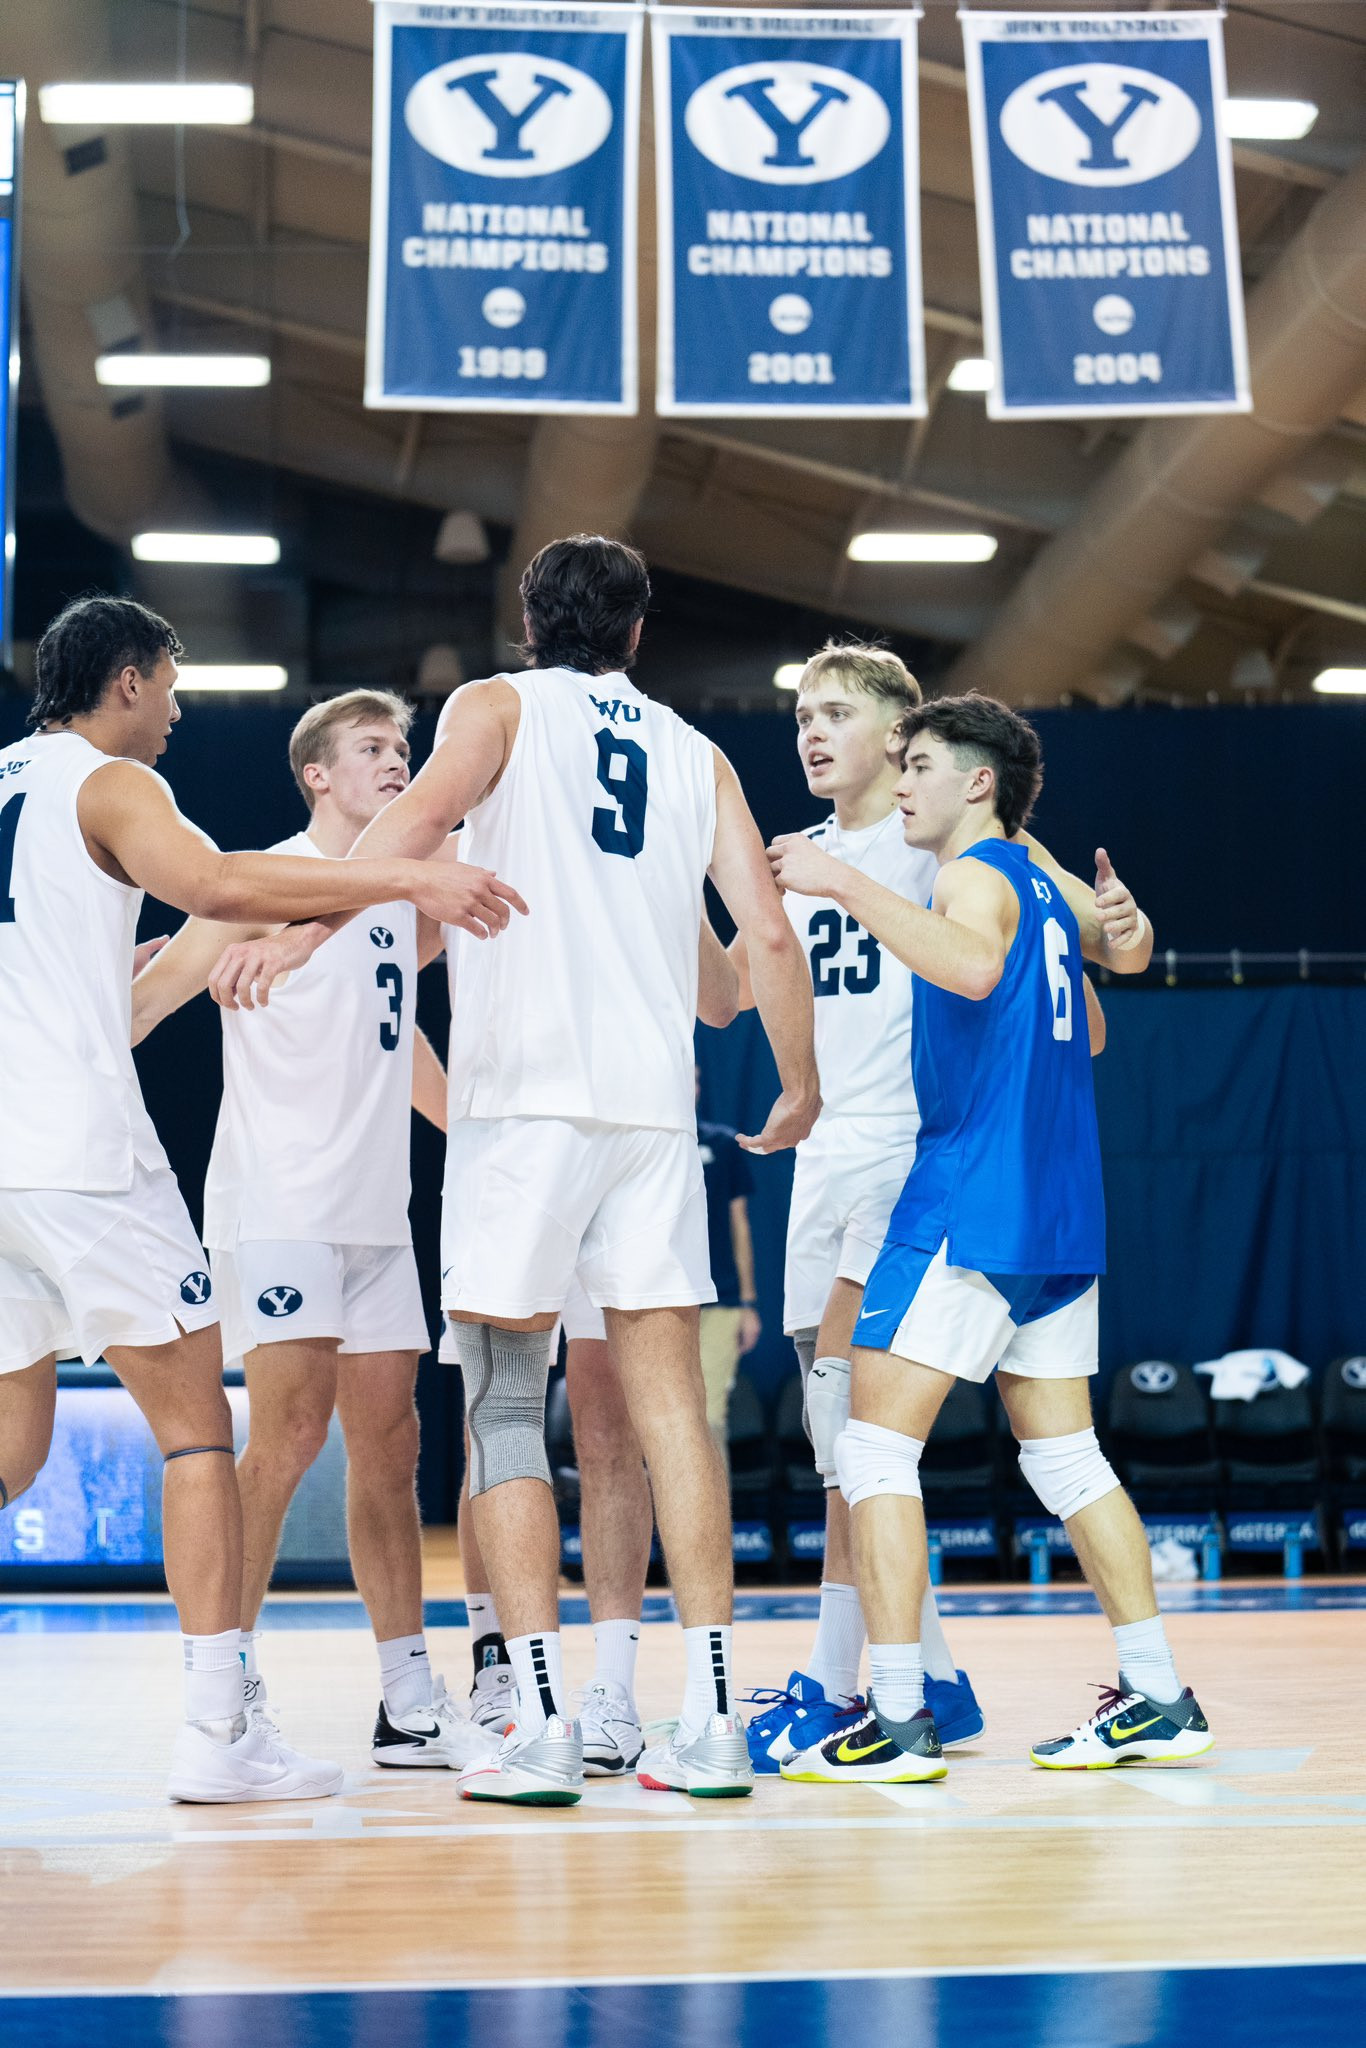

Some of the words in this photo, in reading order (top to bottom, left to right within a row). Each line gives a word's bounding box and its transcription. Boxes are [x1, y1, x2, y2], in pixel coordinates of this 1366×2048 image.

[445, 69, 572, 161] Y
[724, 78, 850, 167] Y
[1036, 80, 1160, 169] Y
[422, 202, 591, 237] NATIONAL
[706, 210, 873, 243] NATIONAL
[1027, 211, 1191, 244] NATIONAL
[402, 236, 609, 274] CHAMPIONS
[687, 244, 893, 278] CHAMPIONS
[1010, 244, 1211, 280] CHAMPIONS
[457, 346, 547, 380] 1999
[747, 352, 835, 385] 2001
[1073, 352, 1163, 385] 2004
[591, 727, 648, 860] 9
[808, 908, 882, 997] 23
[1043, 917, 1073, 1041] 6
[376, 963, 403, 1051] 3
[182, 1273, 207, 1302] Y
[262, 1288, 297, 1316] Y
